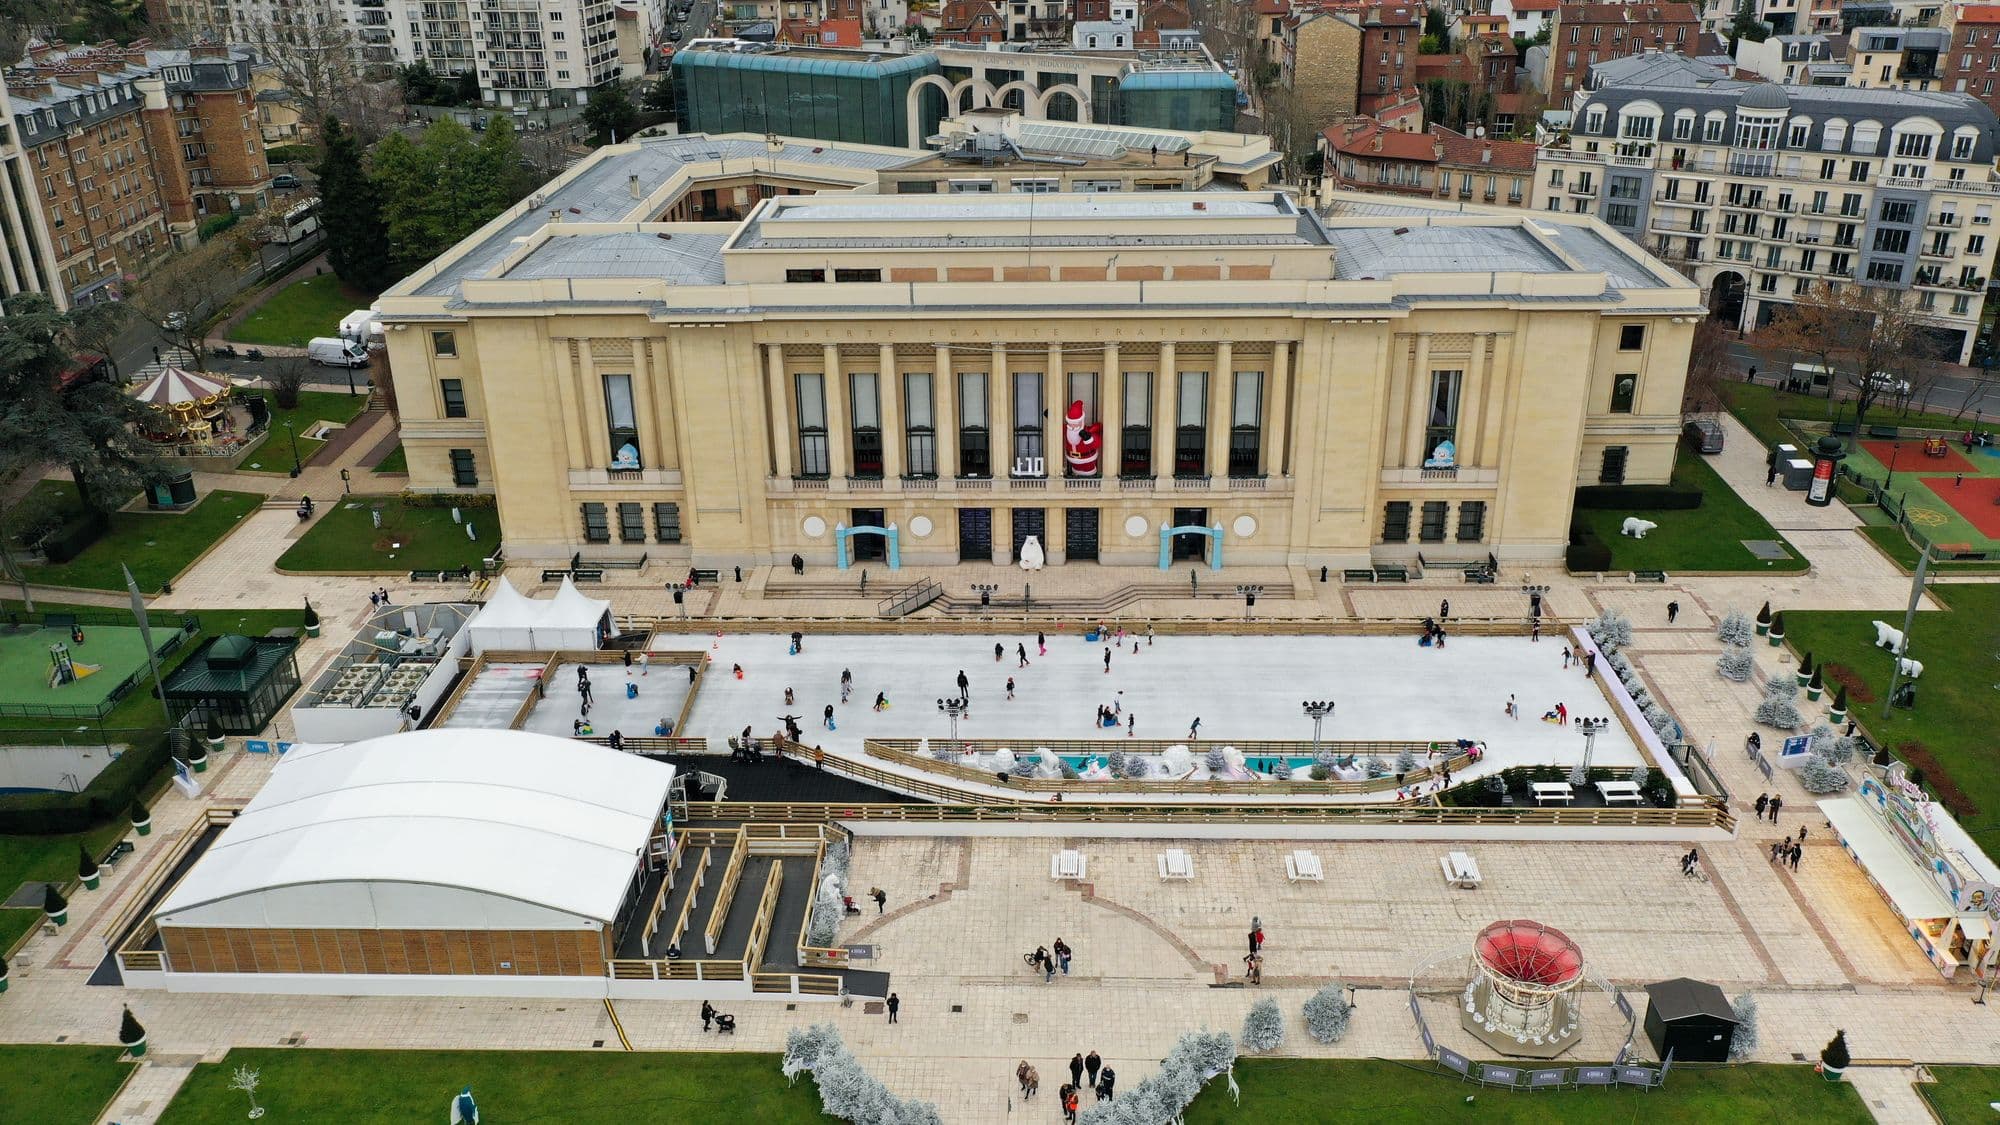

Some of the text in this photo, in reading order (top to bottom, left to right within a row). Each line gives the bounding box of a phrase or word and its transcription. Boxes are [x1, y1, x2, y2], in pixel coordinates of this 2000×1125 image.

[766, 327, 1290, 337] LIBERTE EGALITE FRATERNITE
